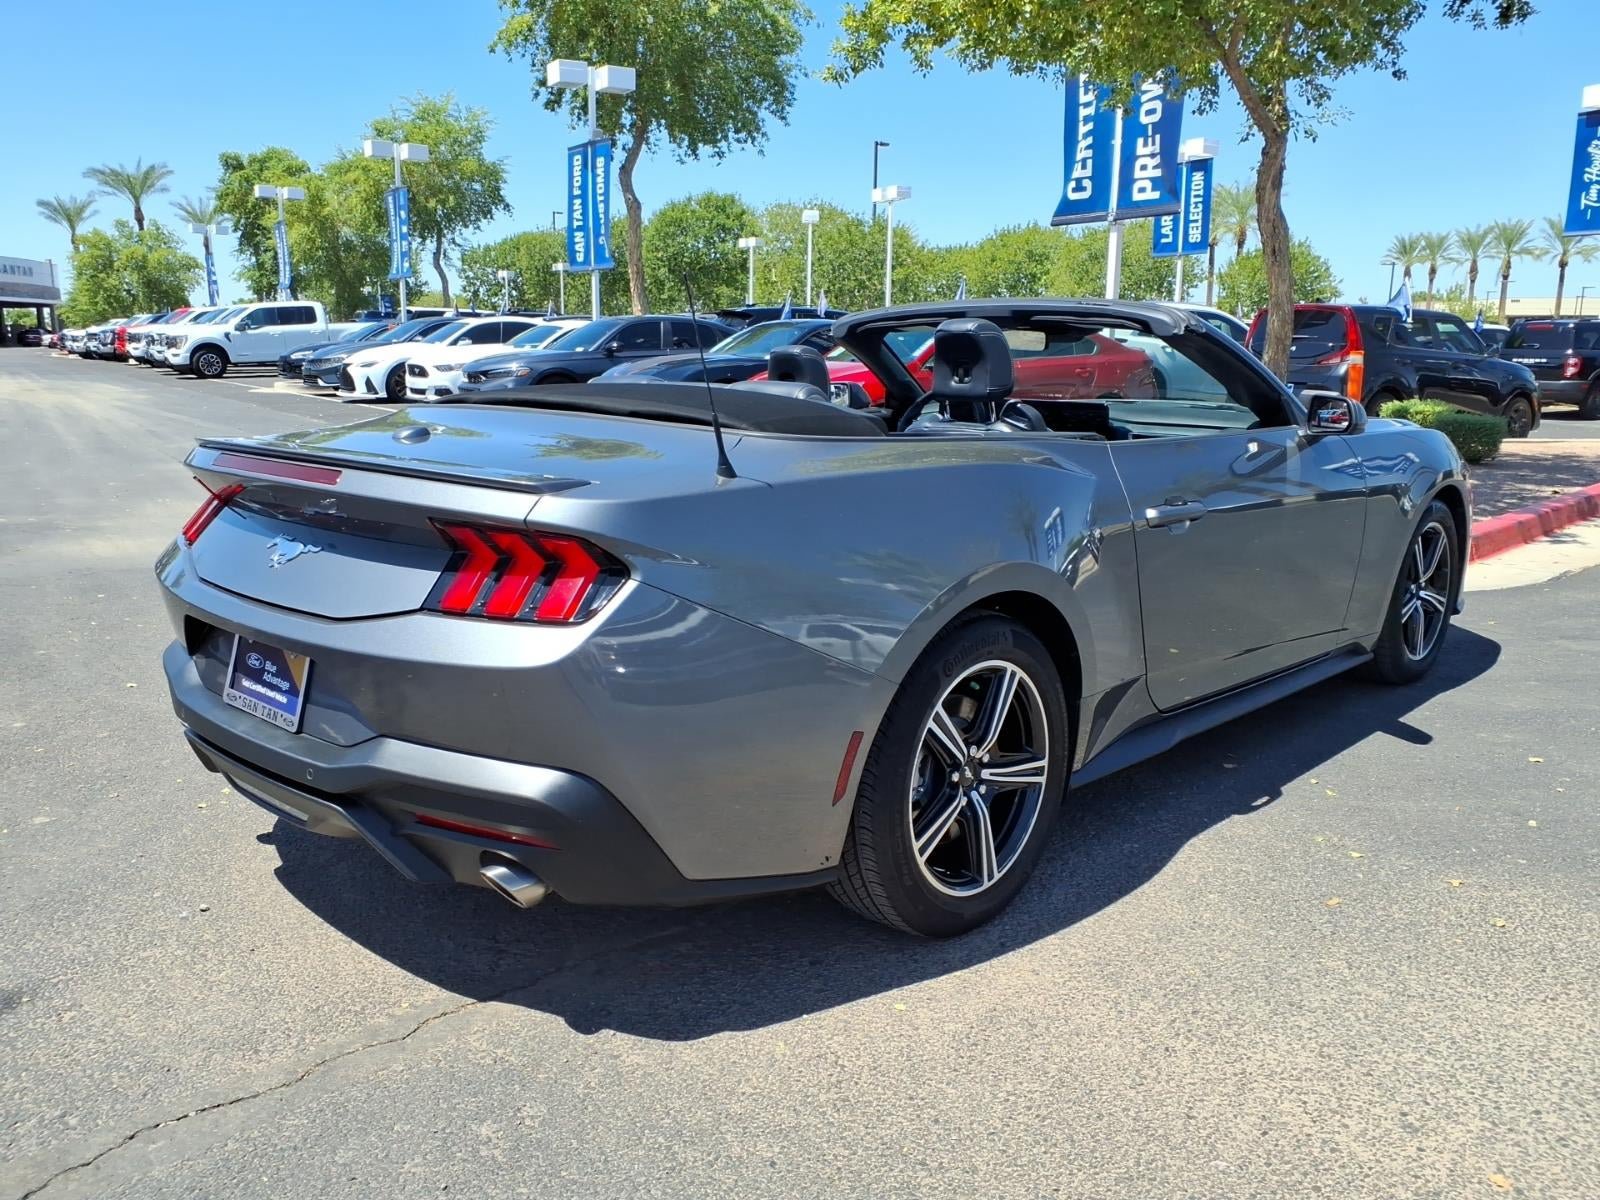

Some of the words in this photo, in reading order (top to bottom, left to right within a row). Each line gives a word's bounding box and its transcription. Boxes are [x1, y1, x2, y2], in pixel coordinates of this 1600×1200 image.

[1067, 72, 1096, 200] CERTIF
[1132, 70, 1164, 201] PRE-OW
[573, 154, 582, 196] FORD
[1189, 171, 1204, 243] SELECTION
[1581, 184, 1600, 209] Tim
[573, 198, 584, 229] TAN
[1160, 215, 1173, 244] LAR
[573, 231, 584, 262] SAN
[262, 671, 290, 691] Advantage
[265, 660, 276, 673] Blue
[241, 696, 259, 713] SAN
[261, 705, 279, 722] TAN
